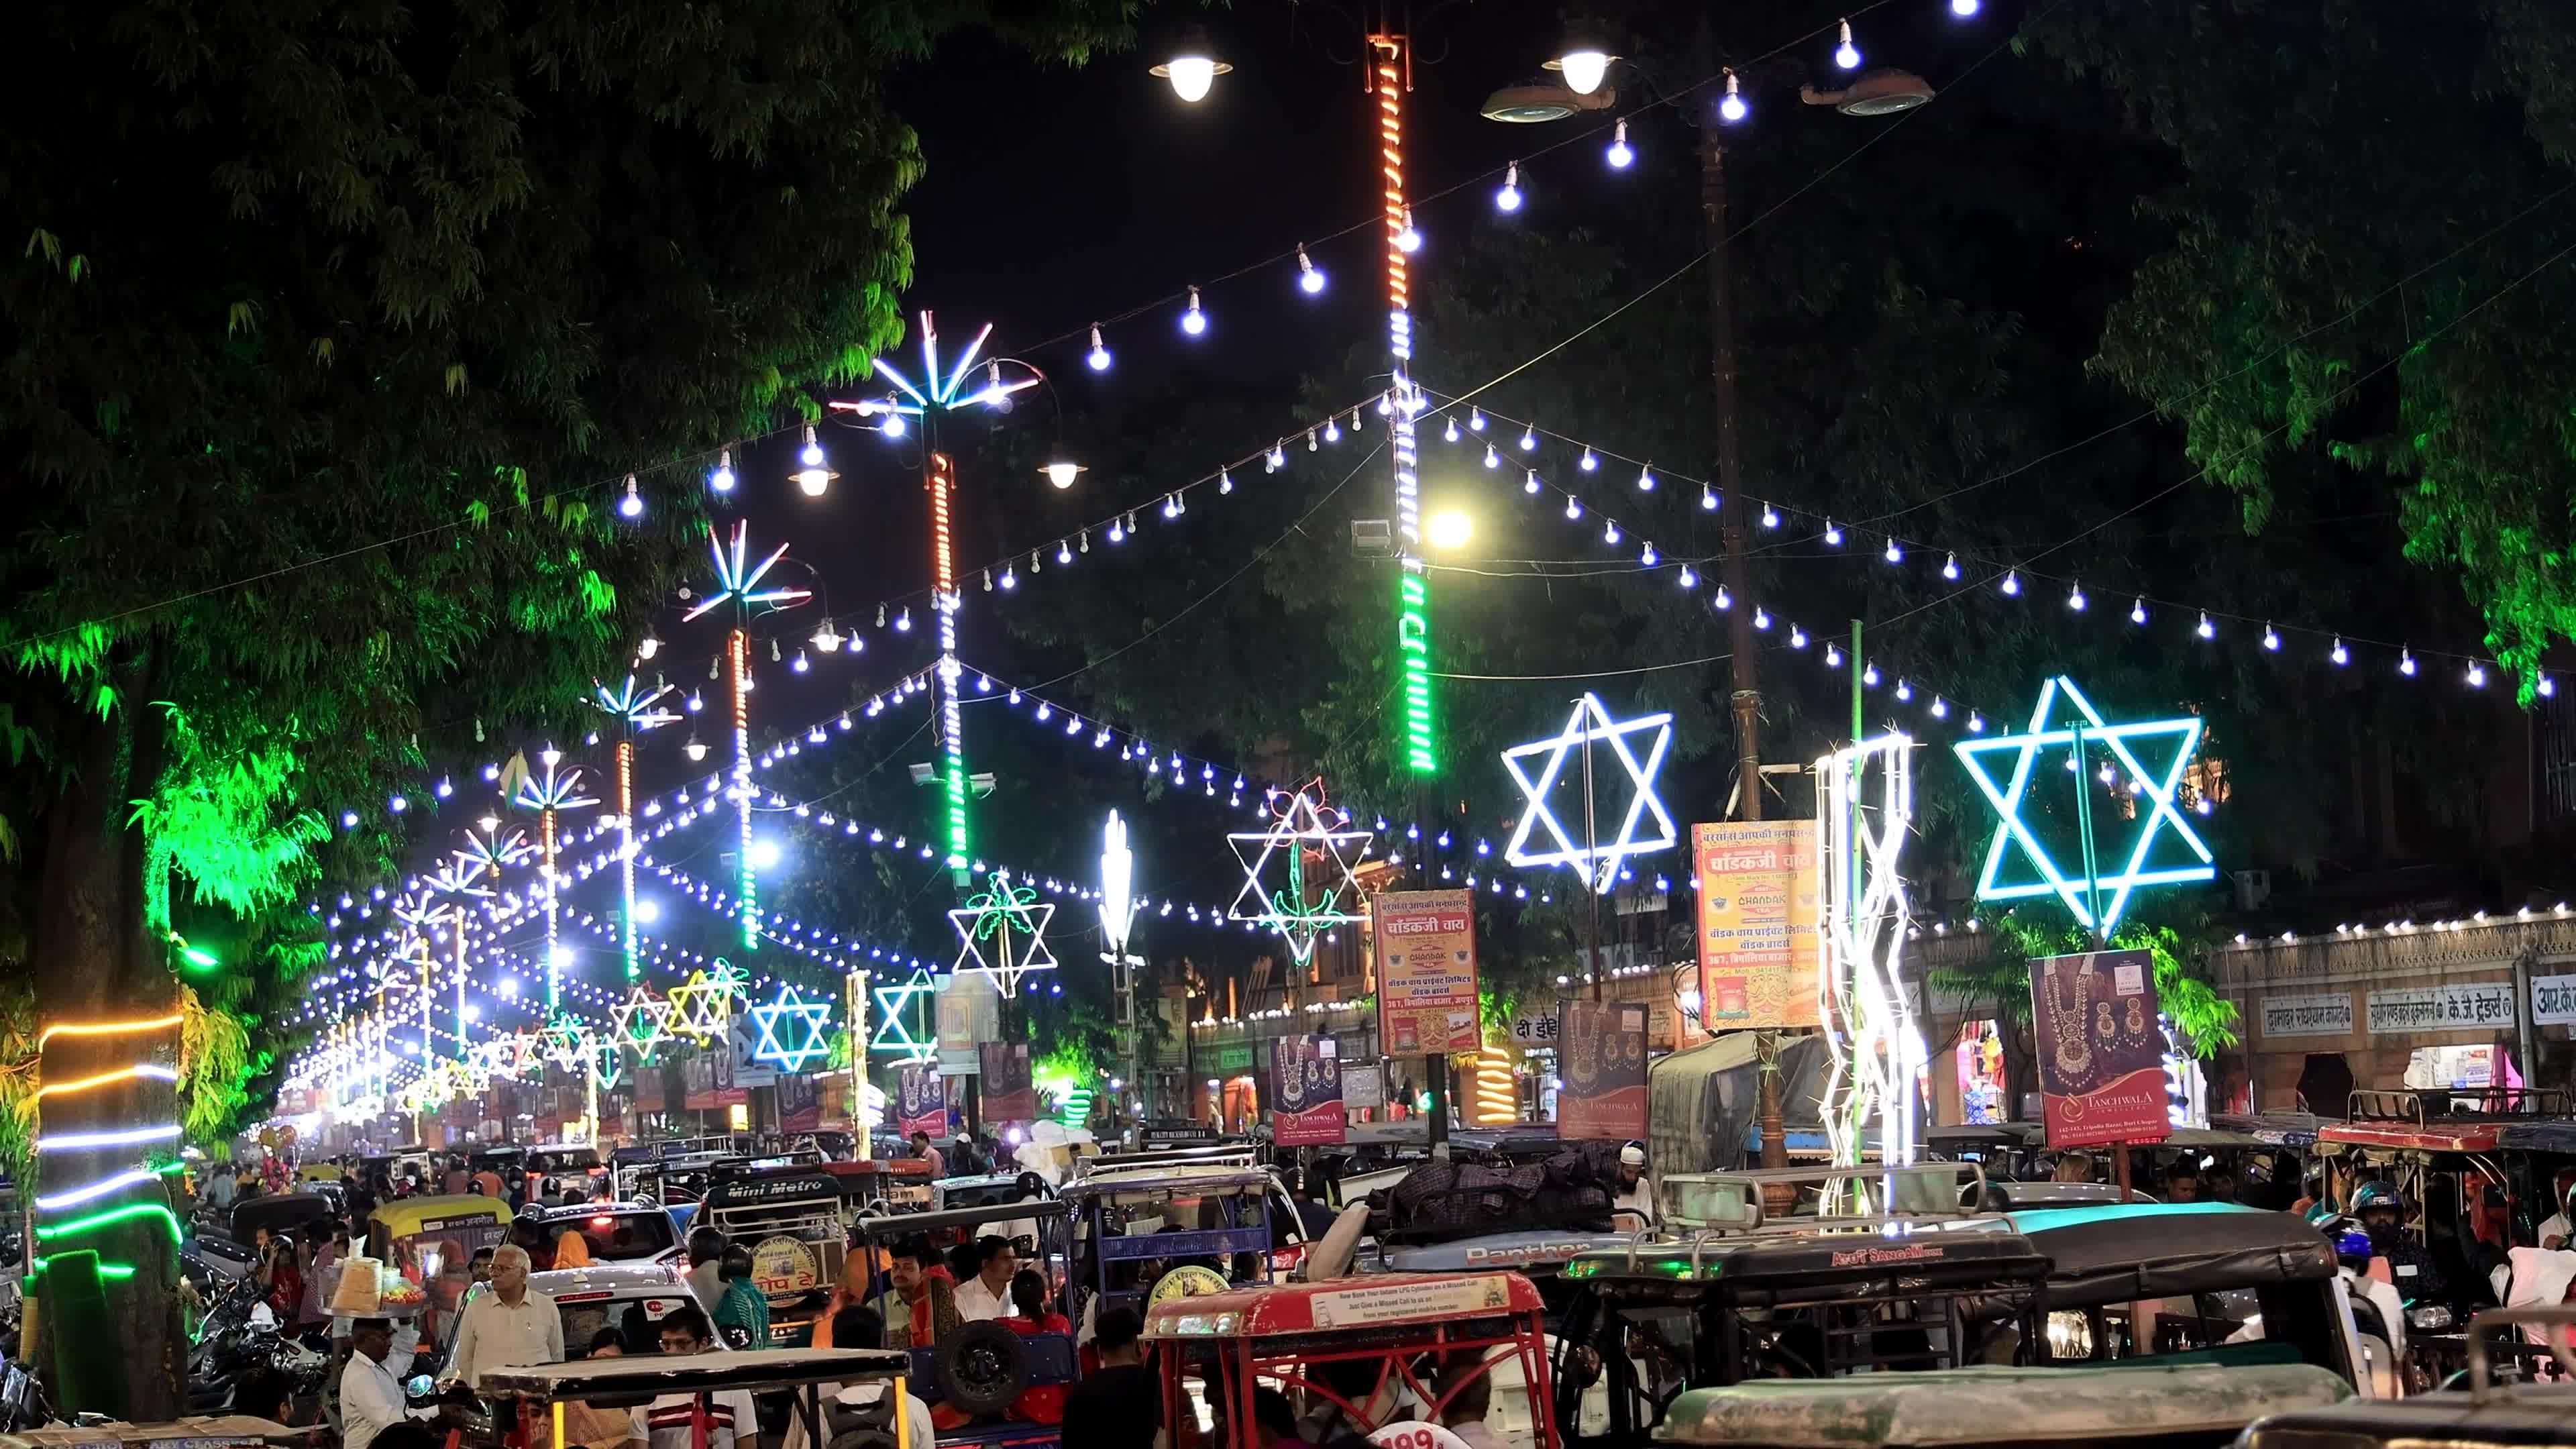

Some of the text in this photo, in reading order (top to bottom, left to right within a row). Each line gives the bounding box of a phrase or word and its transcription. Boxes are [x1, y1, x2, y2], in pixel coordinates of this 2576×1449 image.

[1443, 919, 1464, 930] चाय
[2538, 981, 2576, 1013] आर.के.
[1517, 1019, 1532, 1038] दी
[729, 1181, 822, 1197] Mini Metro
[1466, 1242, 1591, 1267] Panther
[1868, 1244, 1923, 1262] SANGAM
